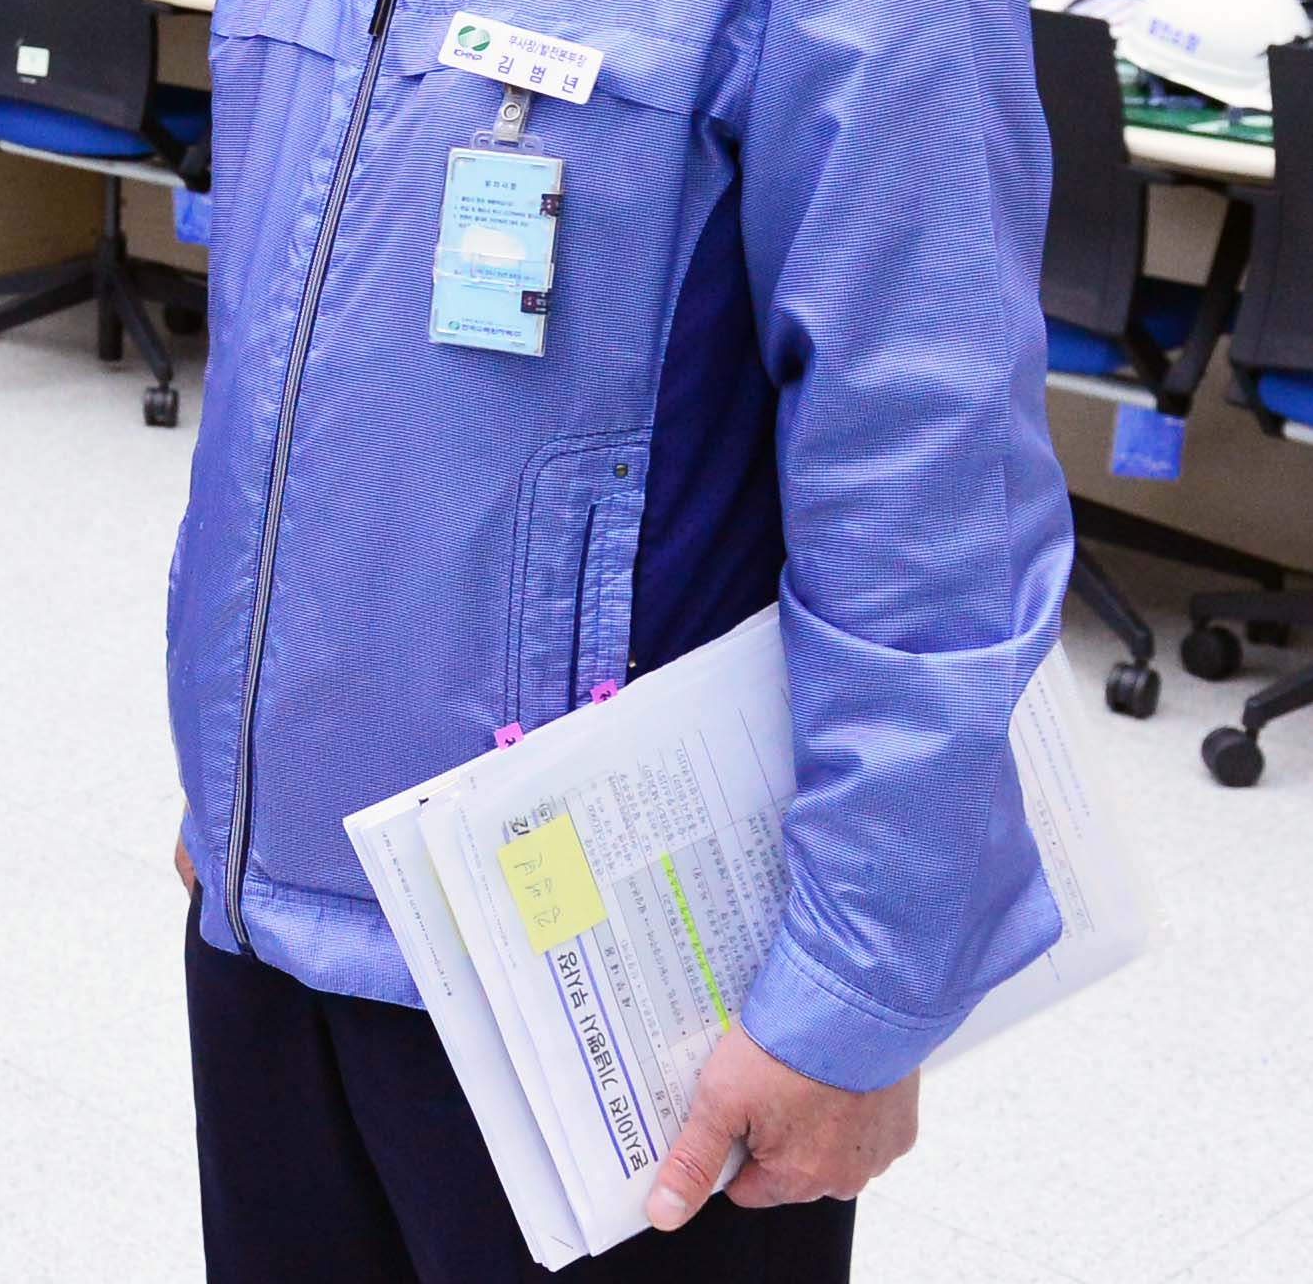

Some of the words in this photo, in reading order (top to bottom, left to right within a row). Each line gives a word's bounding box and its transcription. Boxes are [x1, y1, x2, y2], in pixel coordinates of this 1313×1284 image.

[496, 54, 514, 75] 김
[528, 64, 546, 85] 범
[560, 73, 579, 94] 년
[554, 948, 594, 1009] 부사장
[576, 1012, 622, 1091] 기념행사
[606, 1094, 652, 1172] 본사이전
